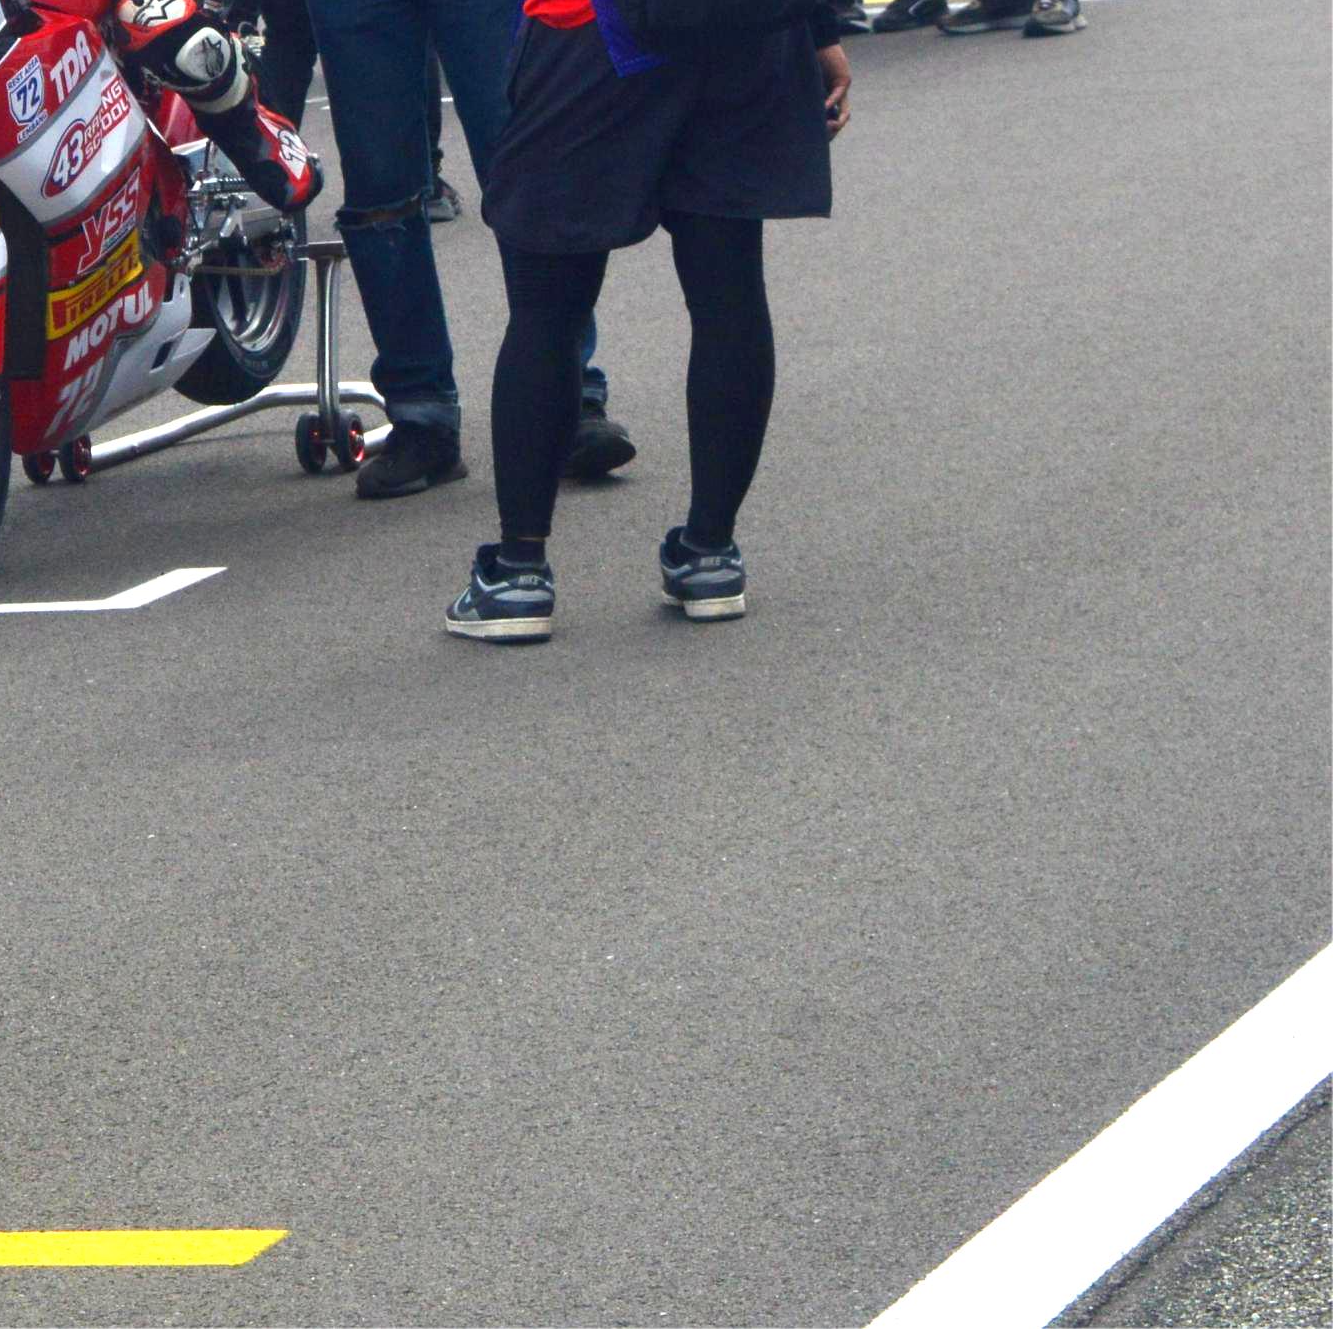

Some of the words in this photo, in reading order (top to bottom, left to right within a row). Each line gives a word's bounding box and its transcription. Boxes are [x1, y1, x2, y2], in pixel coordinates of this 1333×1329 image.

[16, 77, 40, 116] 72
[53, 129, 84, 187] 43
[64, 281, 154, 371] MOTUL
